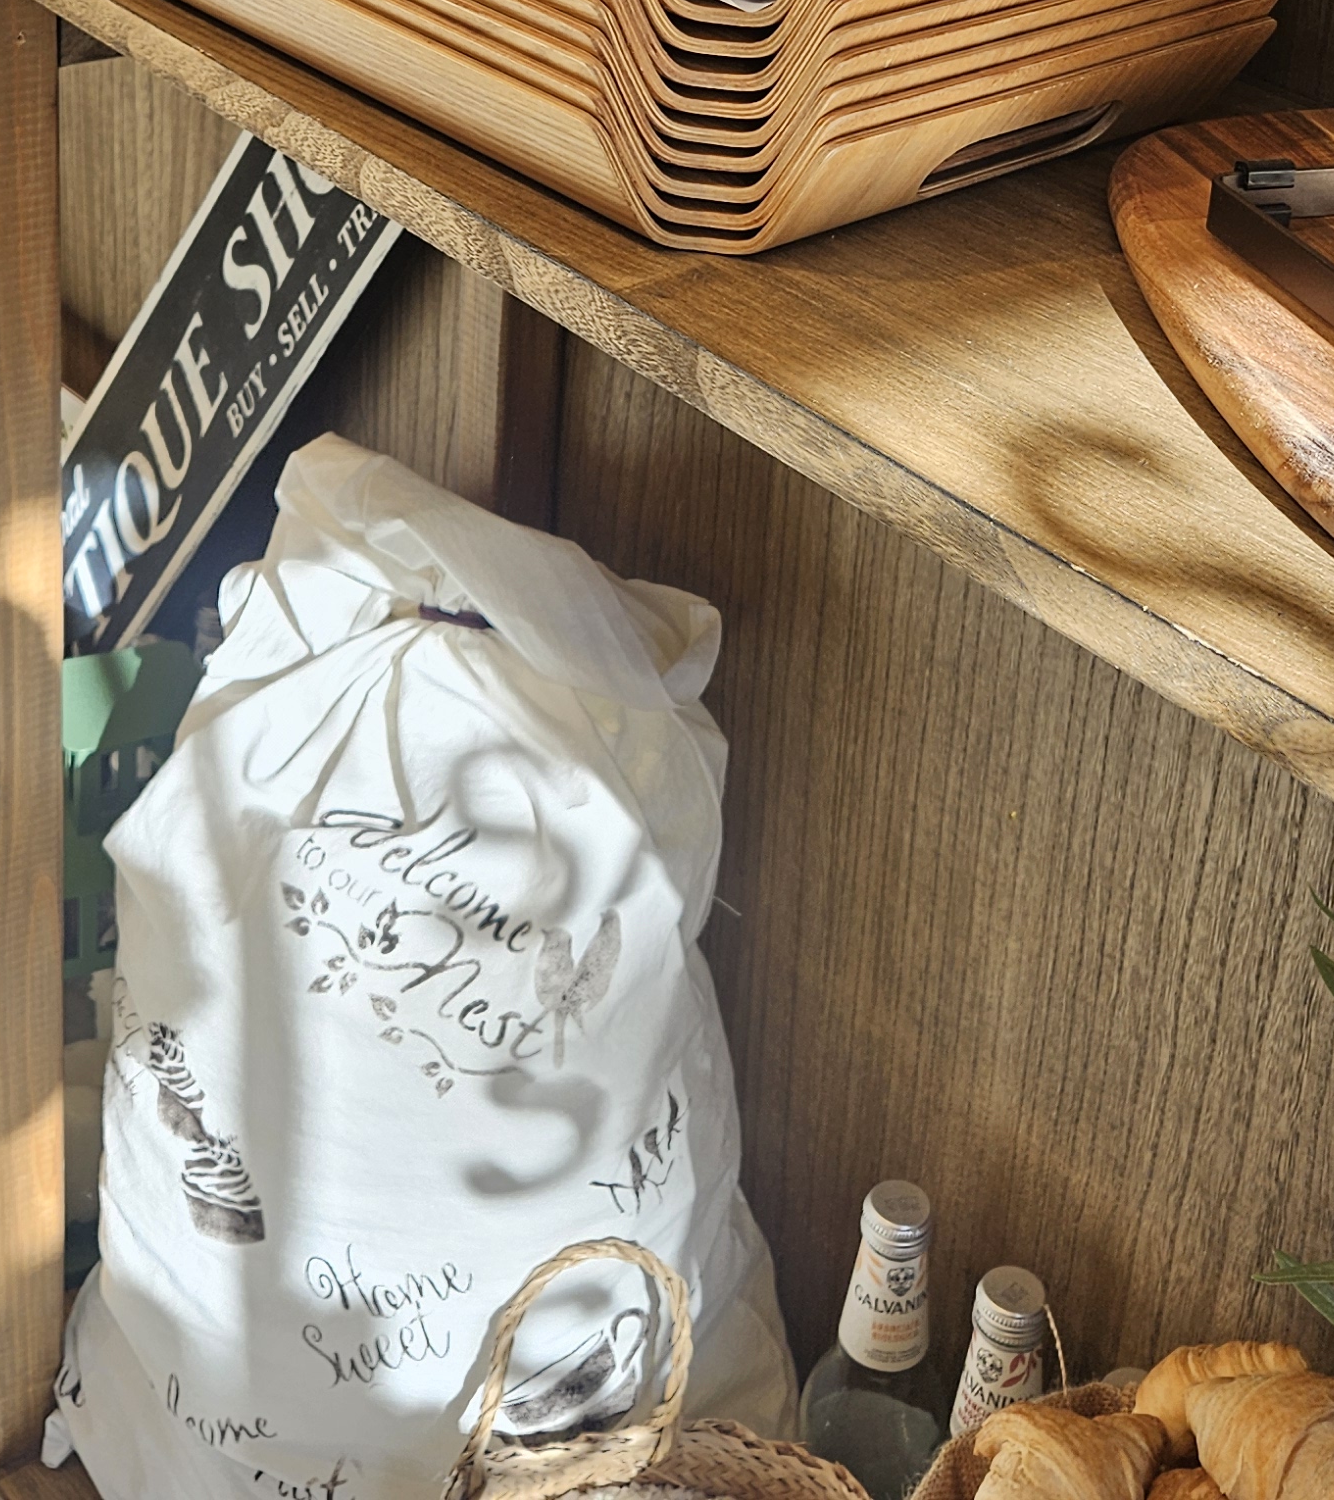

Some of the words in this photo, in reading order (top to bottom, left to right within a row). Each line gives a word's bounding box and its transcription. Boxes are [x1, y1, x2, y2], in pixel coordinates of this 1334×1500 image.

[226, 362, 267, 438] BUY
[276, 274, 330, 358] SELL
[297, 834, 327, 871] to
[328, 868, 383, 908] our
[305, 1243, 473, 1319] Home
[301, 1300, 451, 1389] Sweet
